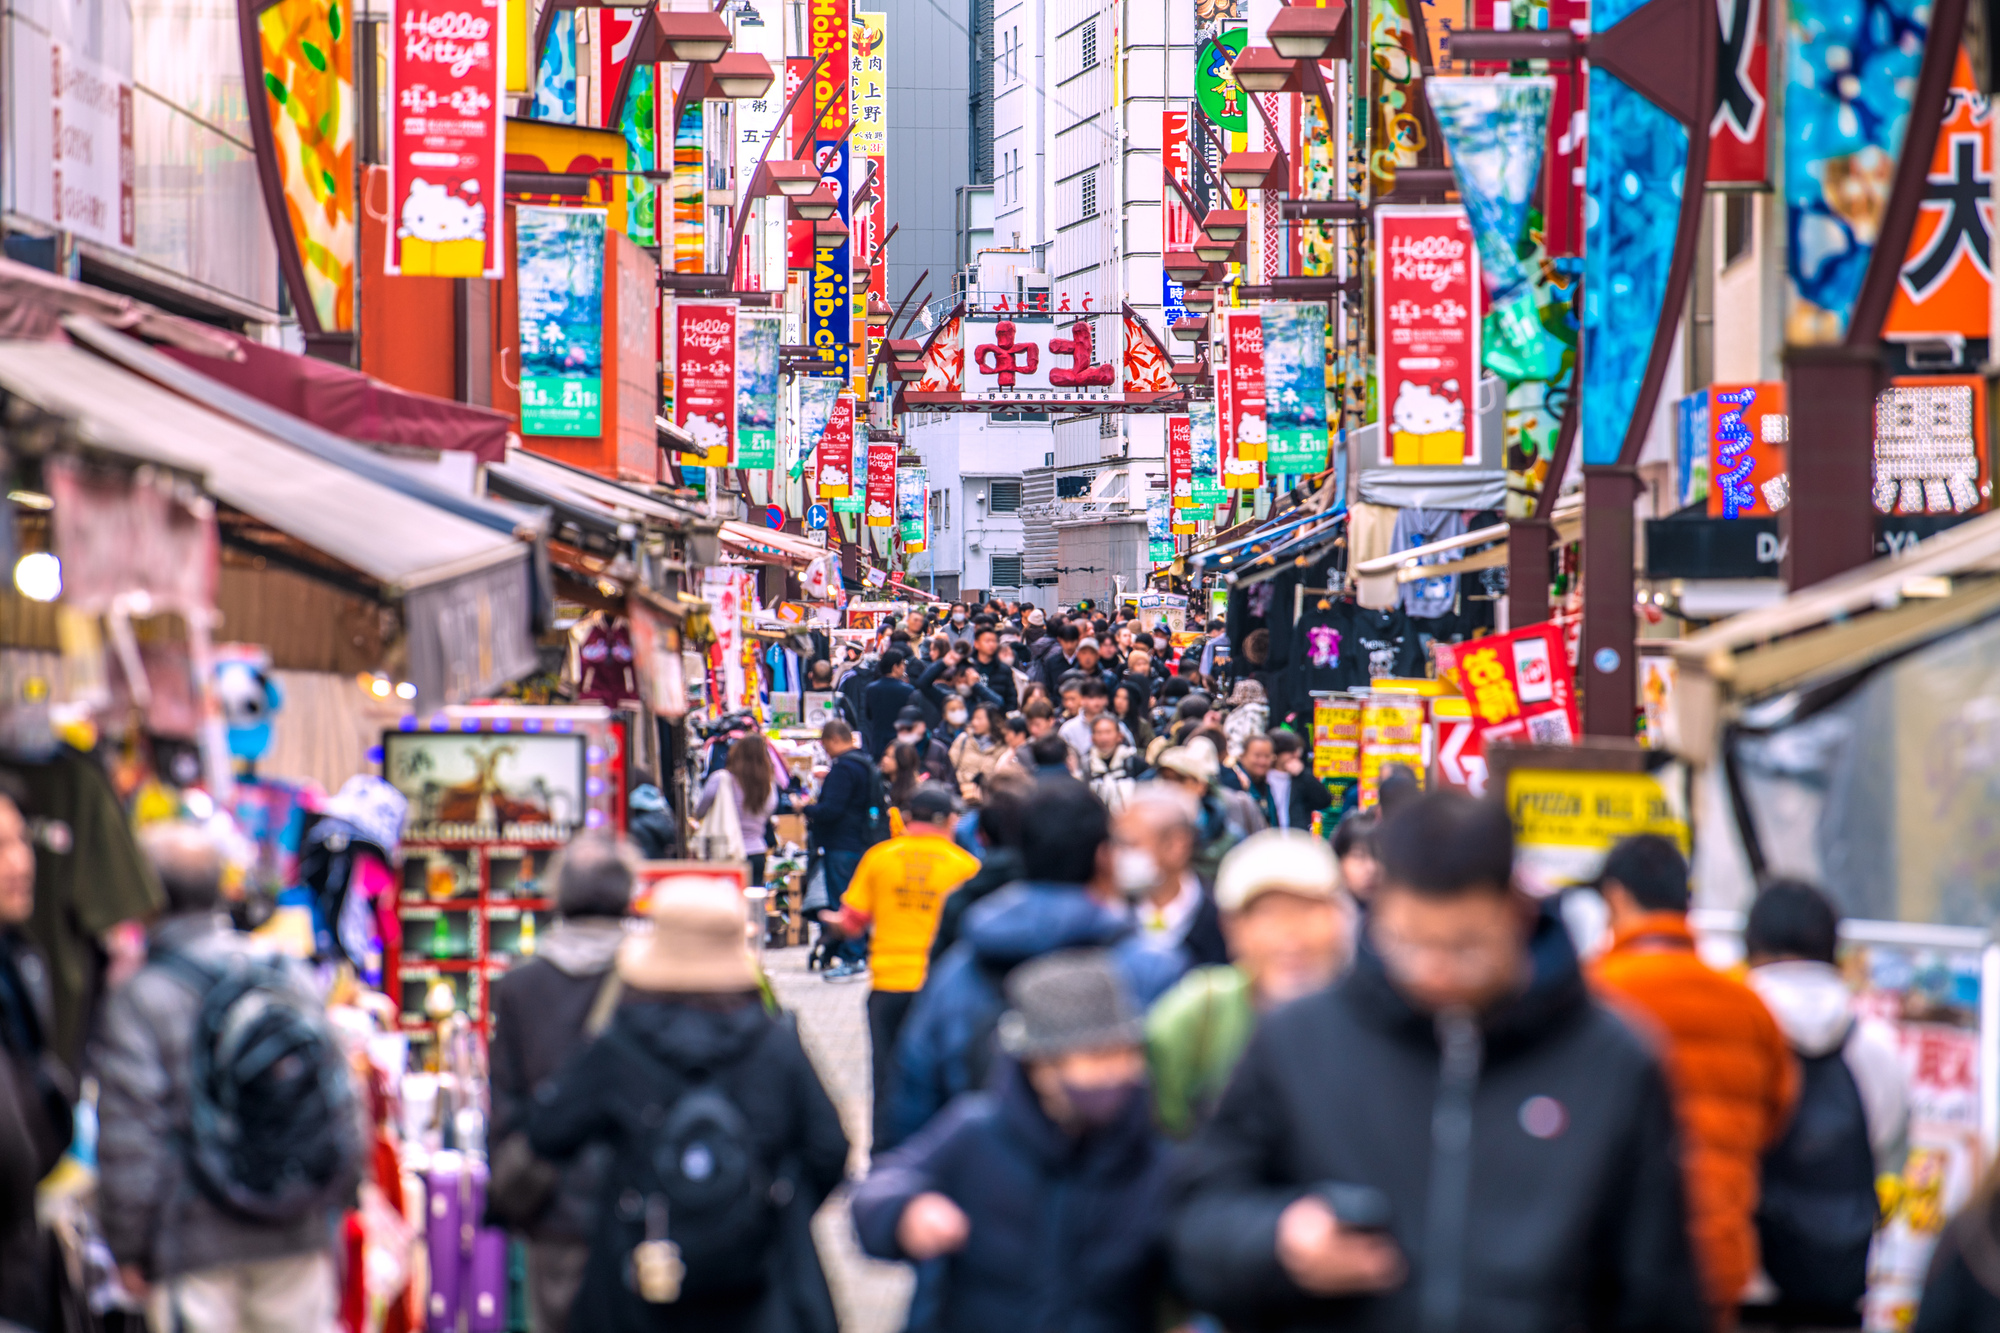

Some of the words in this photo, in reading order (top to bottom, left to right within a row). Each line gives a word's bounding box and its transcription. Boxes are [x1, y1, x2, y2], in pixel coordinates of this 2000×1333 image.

[401, 9, 491, 40] Hello
[405, 36, 476, 78] Kitty
[869, 143, 883, 153] 3F
[820, 152, 838, 168] 3F
[1389, 235, 1464, 260] Hello
[1391, 257, 1454, 293] Kitty
[681, 318, 731, 334] Hello
[1234, 327, 1263, 341] Hel
[683, 332, 723, 355] Kitty
[1173, 425, 1190, 434] Hel
[868, 452, 893, 461] Hello
[869, 460, 889, 471] Kitty
